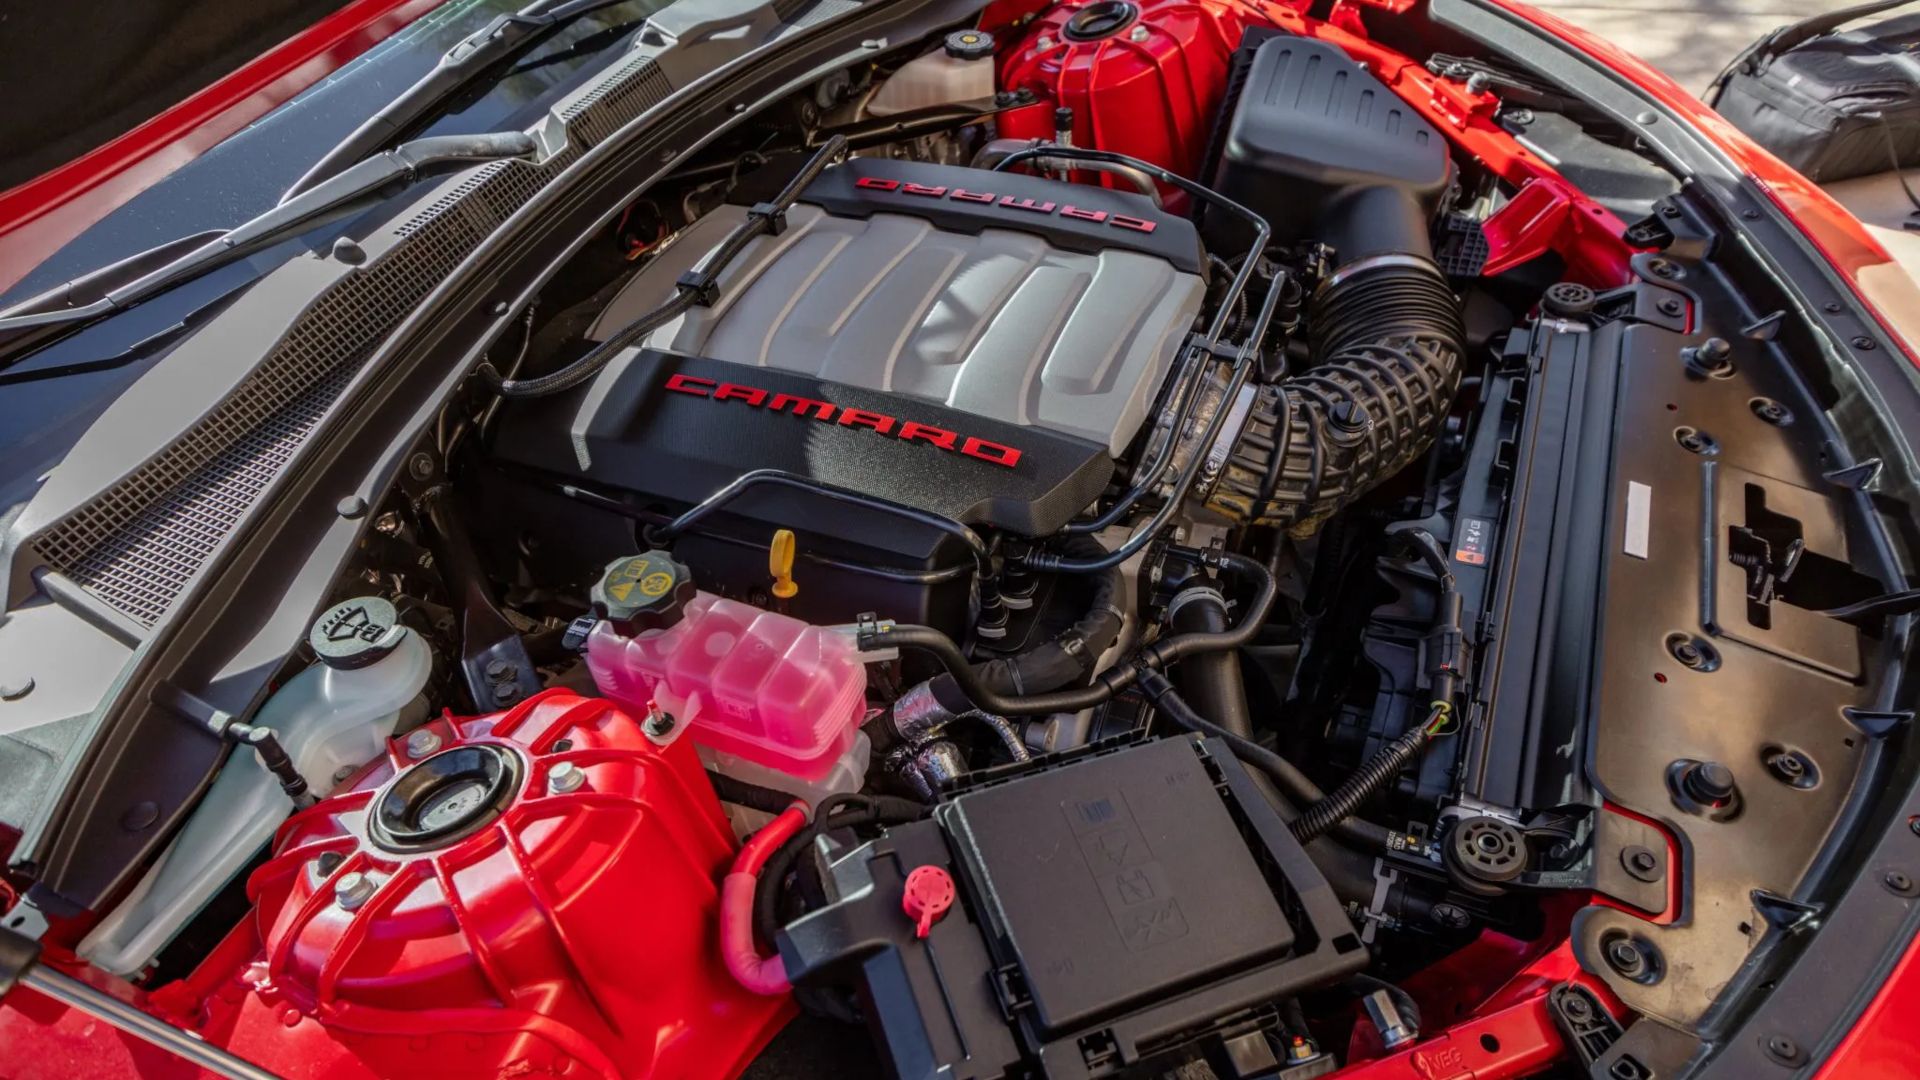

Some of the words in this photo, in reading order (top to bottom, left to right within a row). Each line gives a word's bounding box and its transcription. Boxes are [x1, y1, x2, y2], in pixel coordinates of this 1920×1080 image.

[855, 177, 1157, 232] CAMARO
[665, 374, 1022, 467] CAMARO
[1429, 1047, 1462, 1069] NEG
